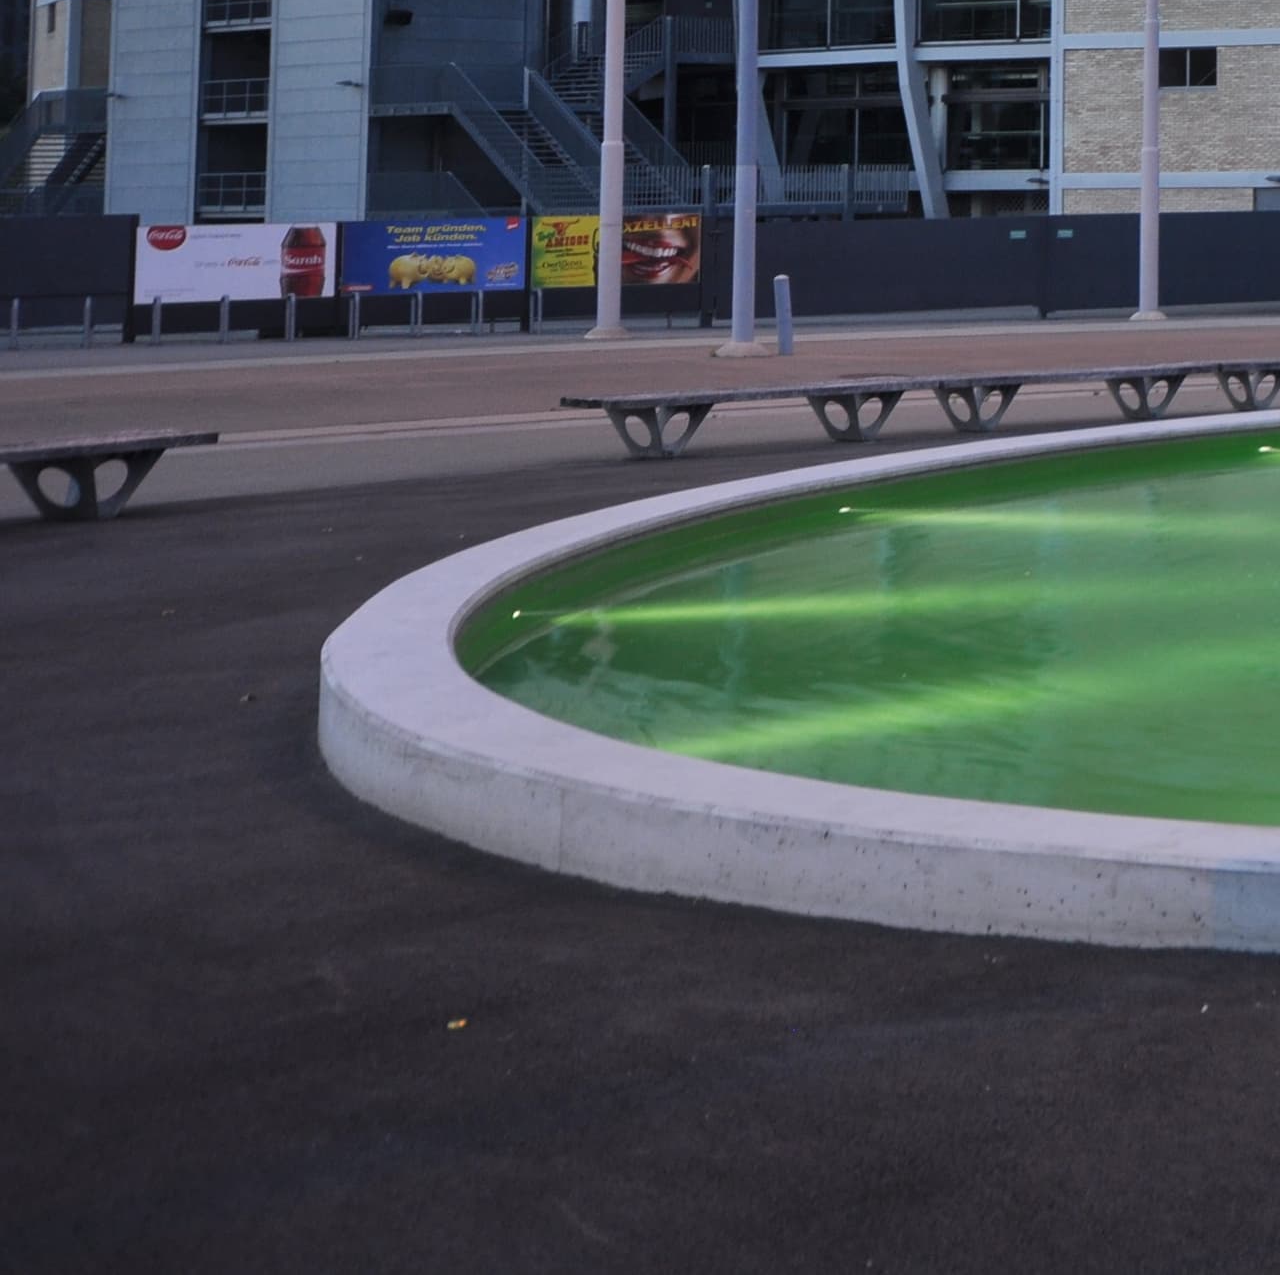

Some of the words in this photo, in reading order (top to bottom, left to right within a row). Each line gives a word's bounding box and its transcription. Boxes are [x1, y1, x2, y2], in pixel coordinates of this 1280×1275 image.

[387, 225, 423, 234] Team
[623, 217, 698, 233] XZELLENT
[394, 234, 421, 243] Job
[283, 255, 322, 266] Sarah
